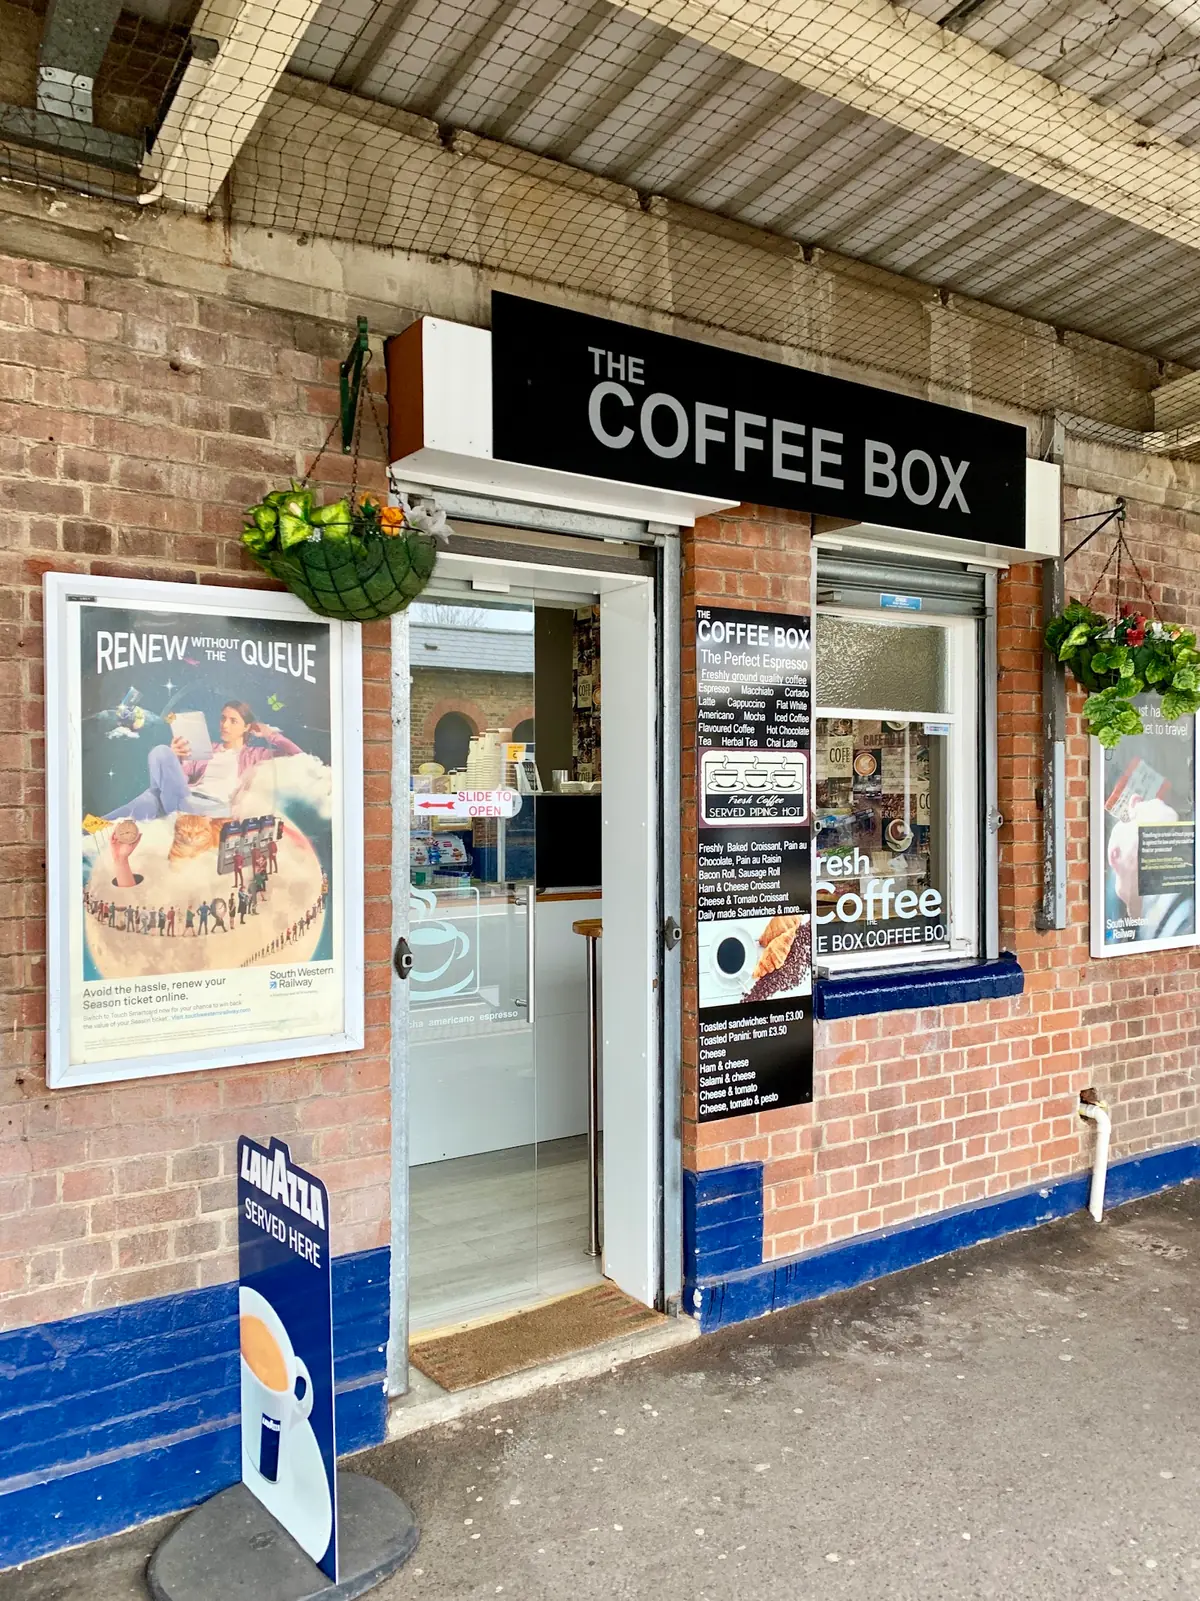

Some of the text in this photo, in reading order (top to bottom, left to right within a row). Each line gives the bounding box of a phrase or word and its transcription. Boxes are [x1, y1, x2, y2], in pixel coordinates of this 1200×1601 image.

[588, 346, 645, 385] THE
[588, 381, 971, 514] COFFEE BOX
[697, 610, 711, 620] THE
[698, 620, 810, 650] COFFEE BOX
[96, 630, 316, 684] RENEW WITHOUT THE QUEUE
[701, 649, 808, 672] The Perfect Espresso
[702, 669, 807, 684] Freshly ground quality coffee
[698, 683, 809, 698] Espresso Macchiato Cortado
[698, 696, 808, 710] Latte Cappuccino Flat White
[698, 710, 810, 723] Americano Mocha Iced Coffee
[698, 723, 732, 733] Flavoured
[733, 724, 755, 734] Coffee
[766, 725, 778, 734] Hot
[779, 726, 810, 736] Chocolate
[1156, 724, 1163, 734] to
[1165, 724, 1188, 736] travel
[698, 736, 798, 748] Tea Herbal Tea Chai Latte
[458, 792, 512, 802] SLIDE TO
[728, 794, 784, 806] Fresh Coffee
[468, 806, 502, 816] OPEN
[709, 808, 746, 817] SERVED
[782, 807, 800, 816] HOT
[699, 843, 724, 854] Freshly
[727, 842, 748, 852] Baked
[751, 842, 782, 852] Croissant,
[784, 840, 798, 850] Pain
[699, 856, 734, 866] Chocolate,
[736, 855, 750, 864] Pain
[762, 854, 782, 864] Raisin
[816, 847, 870, 876] resh
[699, 867, 780, 880] Bacon Roll, Sausage Roll
[699, 880, 780, 893] Ham & Cheese Croissant
[698, 892, 789, 906] Cheese & Tomato Croissant
[816, 878, 942, 924] Coffee
[698, 910, 716, 920] Daily
[717, 909, 736, 918] made
[738, 906, 776, 917] Sandwiches
[777, 905, 782, 914] &
[1106, 918, 1124, 929] South
[832, 933, 864, 952] BOX
[866, 926, 920, 947] COFFEE
[1113, 928, 1136, 940] Railway
[270, 967, 334, 980] South Western
[83, 978, 226, 998] Avoid the hassle, renew your
[279, 978, 313, 988] Railway
[83, 992, 188, 1010] Season ticket online.
[428, 1014, 474, 1027] americano
[480, 1010, 518, 1021] espresso
[700, 1010, 804, 1032] Toasted sandwiches: from £3.00
[700, 1034, 728, 1046] Toasted
[752, 1028, 768, 1038] from
[769, 1026, 788, 1037] £3.50
[700, 1049, 726, 1060] Cheese
[700, 1059, 750, 1074] Ham & cheese
[700, 1071, 756, 1088] Salami & cheese
[700, 1084, 758, 1100] Cheese & tomato
[700, 1093, 778, 1114] Cheese, tomato & pesto
[241, 1144, 326, 1230] LAVAZZA
[245, 1198, 321, 1269] SERVED HERE
